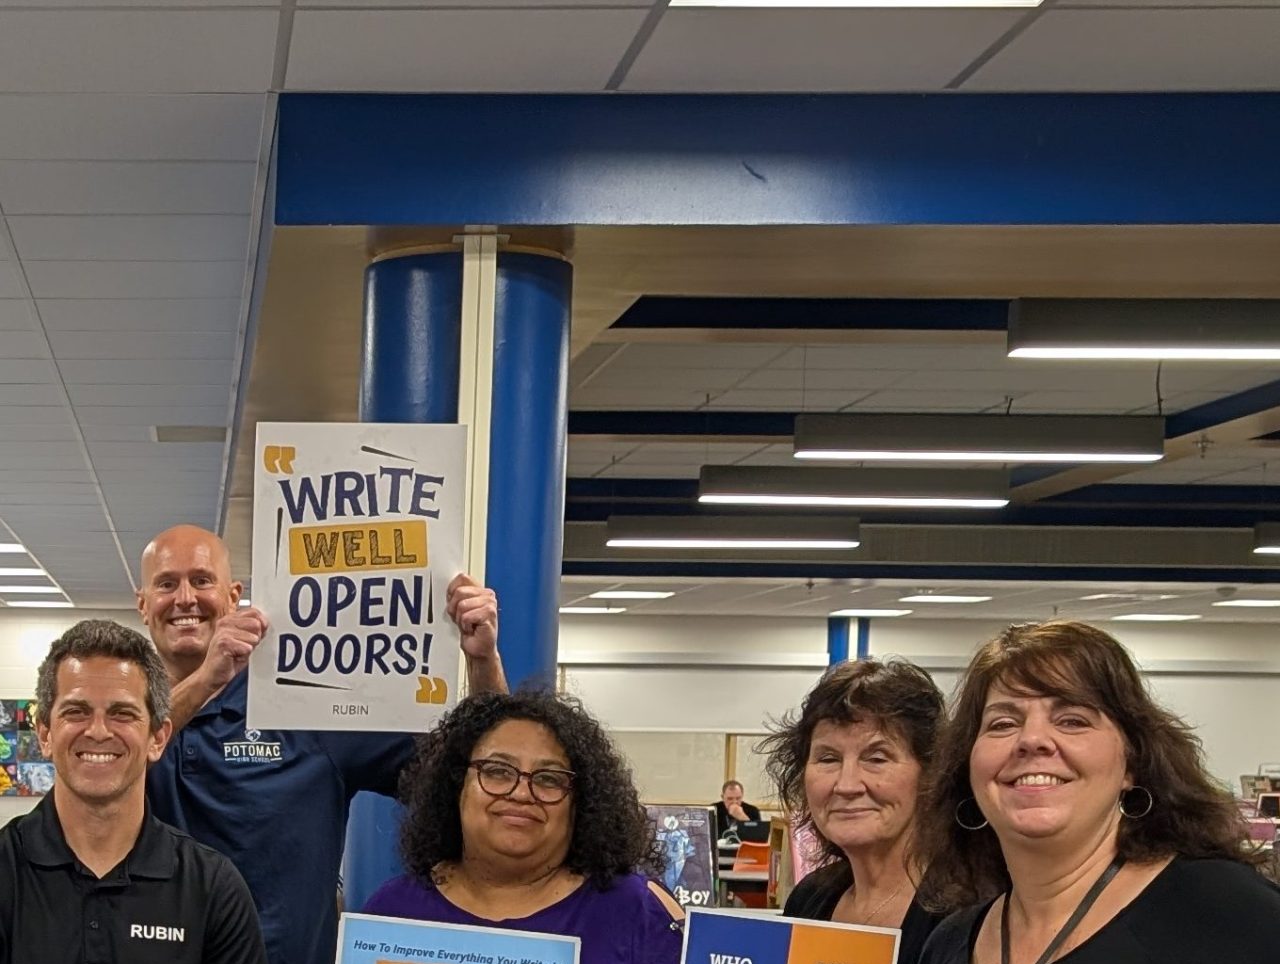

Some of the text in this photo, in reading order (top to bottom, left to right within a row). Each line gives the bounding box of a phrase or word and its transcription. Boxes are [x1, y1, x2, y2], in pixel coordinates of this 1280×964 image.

[278, 466, 444, 523] WRITE
[303, 529, 417, 568] WELL
[289, 576, 423, 627] OPEN
[277, 633, 433, 675] DOORS!
[332, 705, 368, 715] RUBIN
[224, 746, 280, 757] POTOMAC
[131, 924, 184, 942] RUBIN
[354, 940, 376, 952] How
[379, 943, 391, 953] To
[393, 944, 435, 960] Improve
